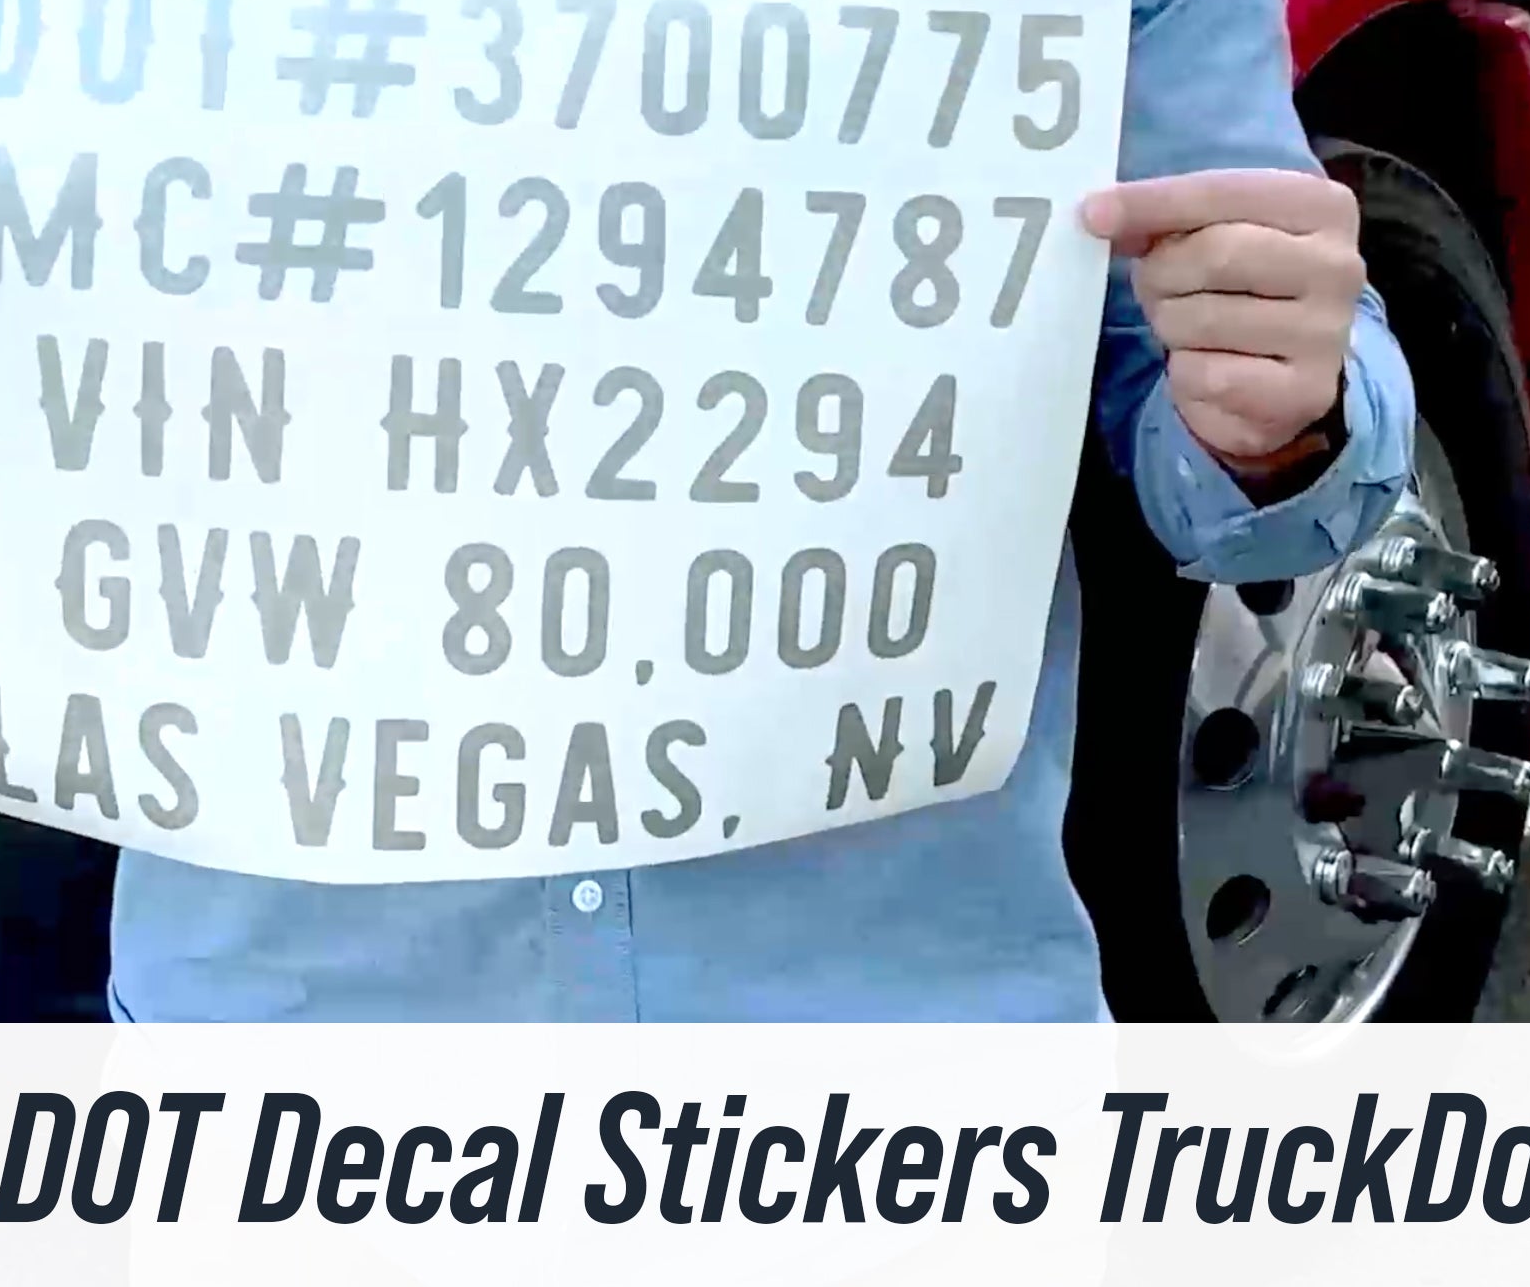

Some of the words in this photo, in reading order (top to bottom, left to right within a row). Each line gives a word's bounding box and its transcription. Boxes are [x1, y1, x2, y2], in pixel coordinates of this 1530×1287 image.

[36, 334, 291, 483] VIN
[379, 353, 964, 504] HX2294
[54, 518, 360, 669] GVW
[441, 541, 938, 687] 80,000
[279, 712, 741, 851] VEGAS,
[825, 680, 998, 811] NV
